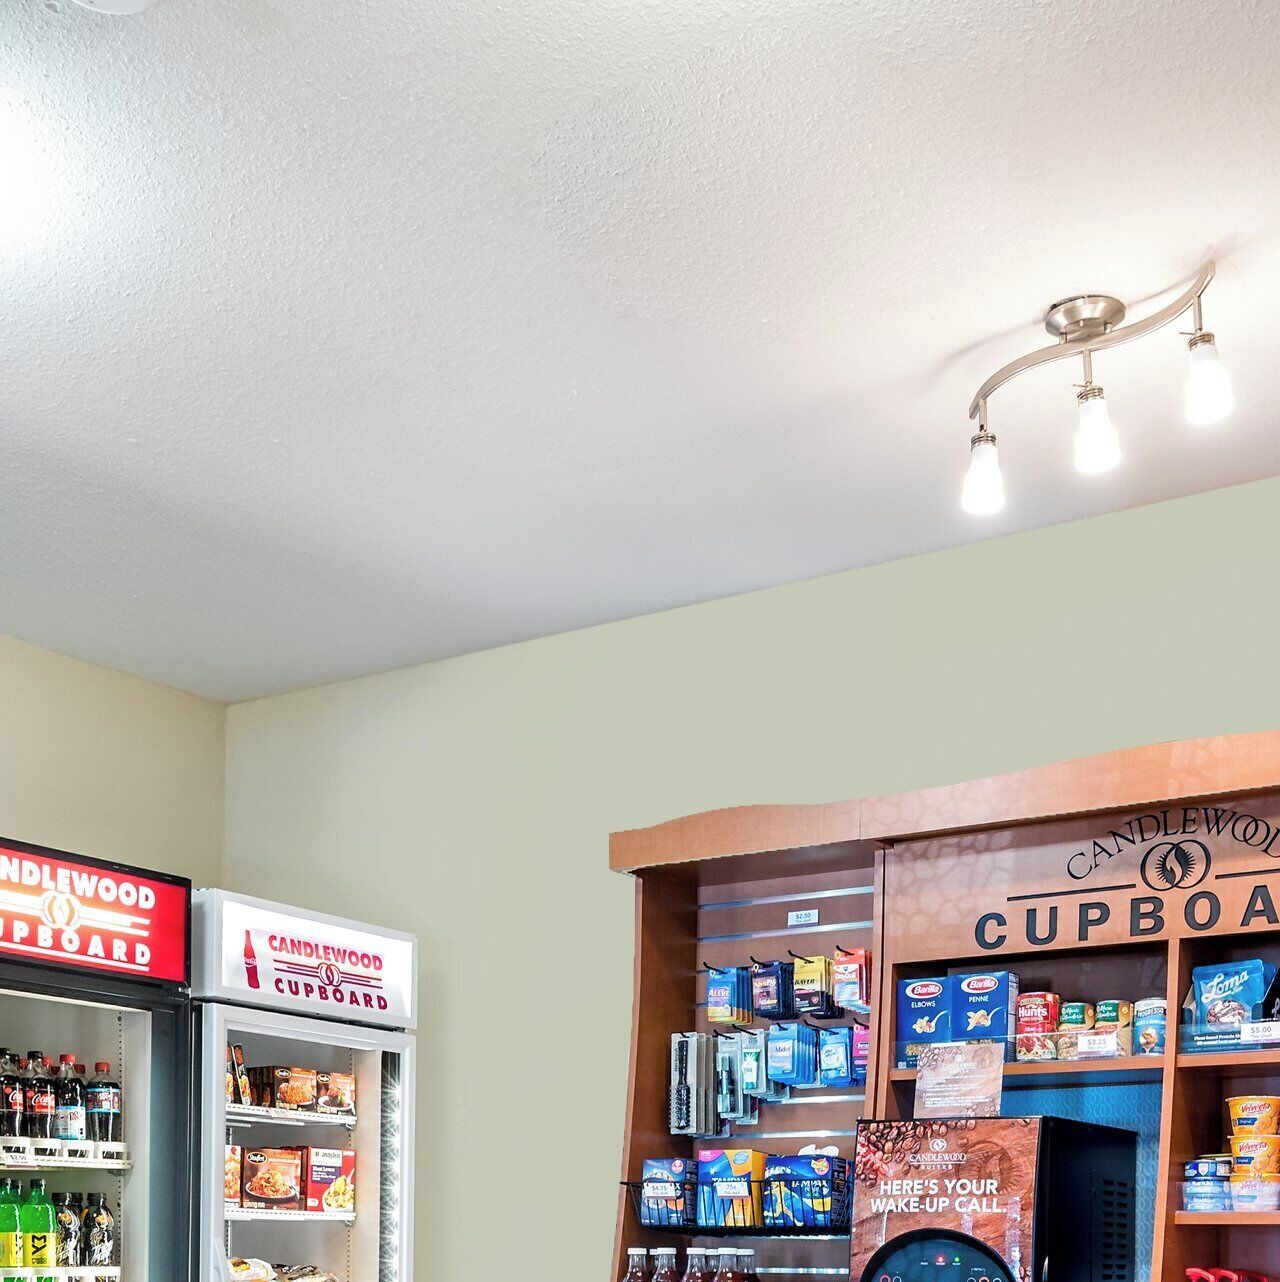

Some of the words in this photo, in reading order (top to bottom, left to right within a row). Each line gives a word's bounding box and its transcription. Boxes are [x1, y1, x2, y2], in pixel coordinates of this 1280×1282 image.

[795, 912, 811, 920] $2.50
[268, 934, 383, 972] CANDLEWOOD
[914, 983, 939, 996] Barilla
[970, 978, 997, 991] Barilla
[273, 977, 389, 1012] CUPBOARD
[708, 988, 731, 997] ALEVE
[911, 1000, 936, 1008] ELBOWS
[968, 995, 989, 1003] PENNE
[1250, 1026, 1272, 1034] $5.00
[1088, 1038, 1107, 1046] $3.25
[1239, 1102, 1271, 1114] Velveeta
[1237, 1142, 1269, 1152] Velveeta
[909, 1154, 966, 1164] CANDLEWOOD
[880, 1179, 938, 1195] HERE'S
[944, 1178, 998, 1195] YOUR
[871, 1198, 953, 1214] WAKE-UP
[957, 1197, 1007, 1213] CALL.
